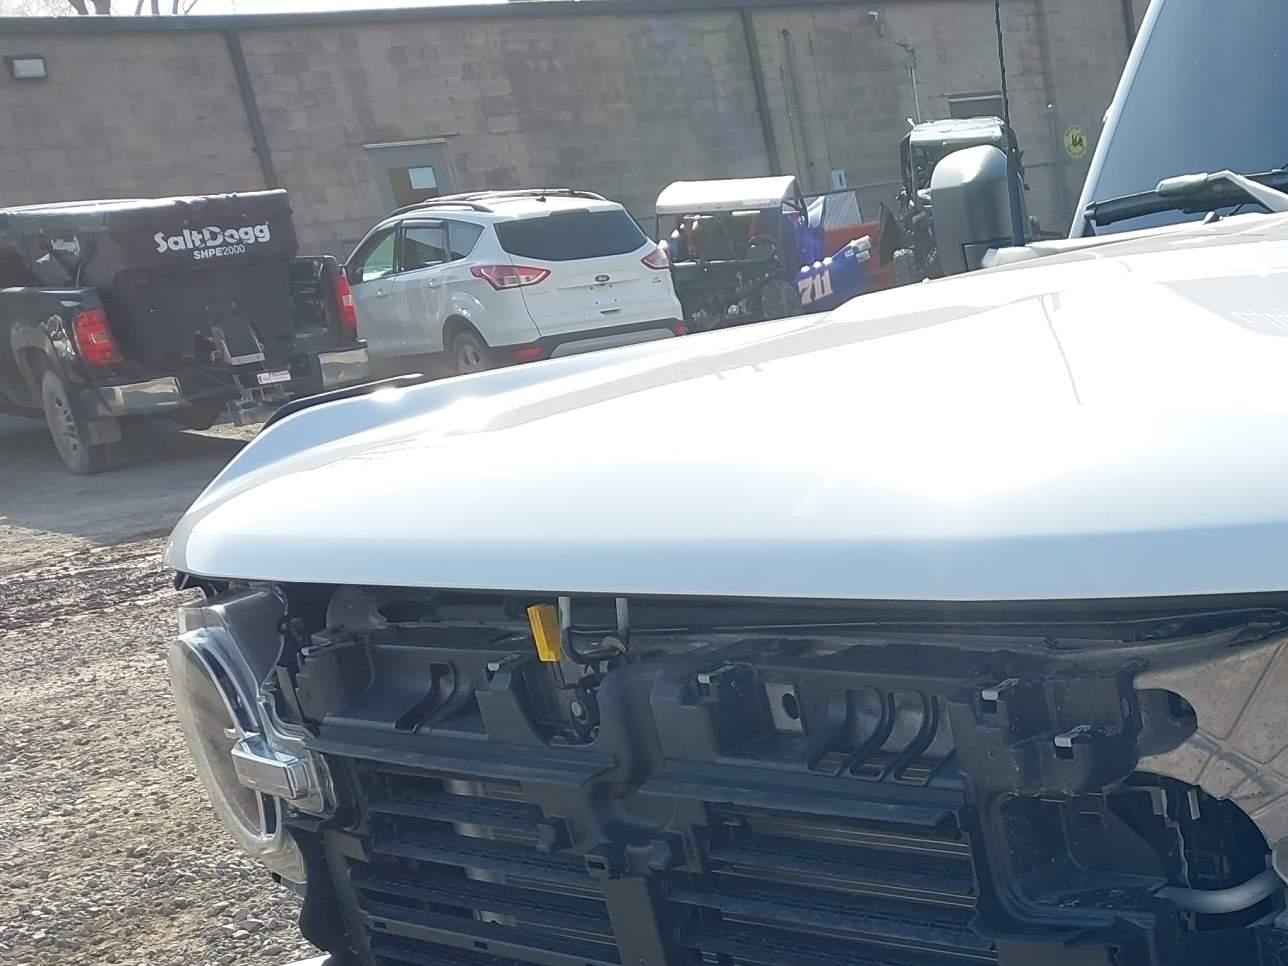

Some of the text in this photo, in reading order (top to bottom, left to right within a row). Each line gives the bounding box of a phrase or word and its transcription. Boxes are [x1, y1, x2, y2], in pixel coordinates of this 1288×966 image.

[154, 224, 271, 253] SaltDogg
[193, 244, 245, 260] SHPE2000
[798, 269, 833, 305] 711
